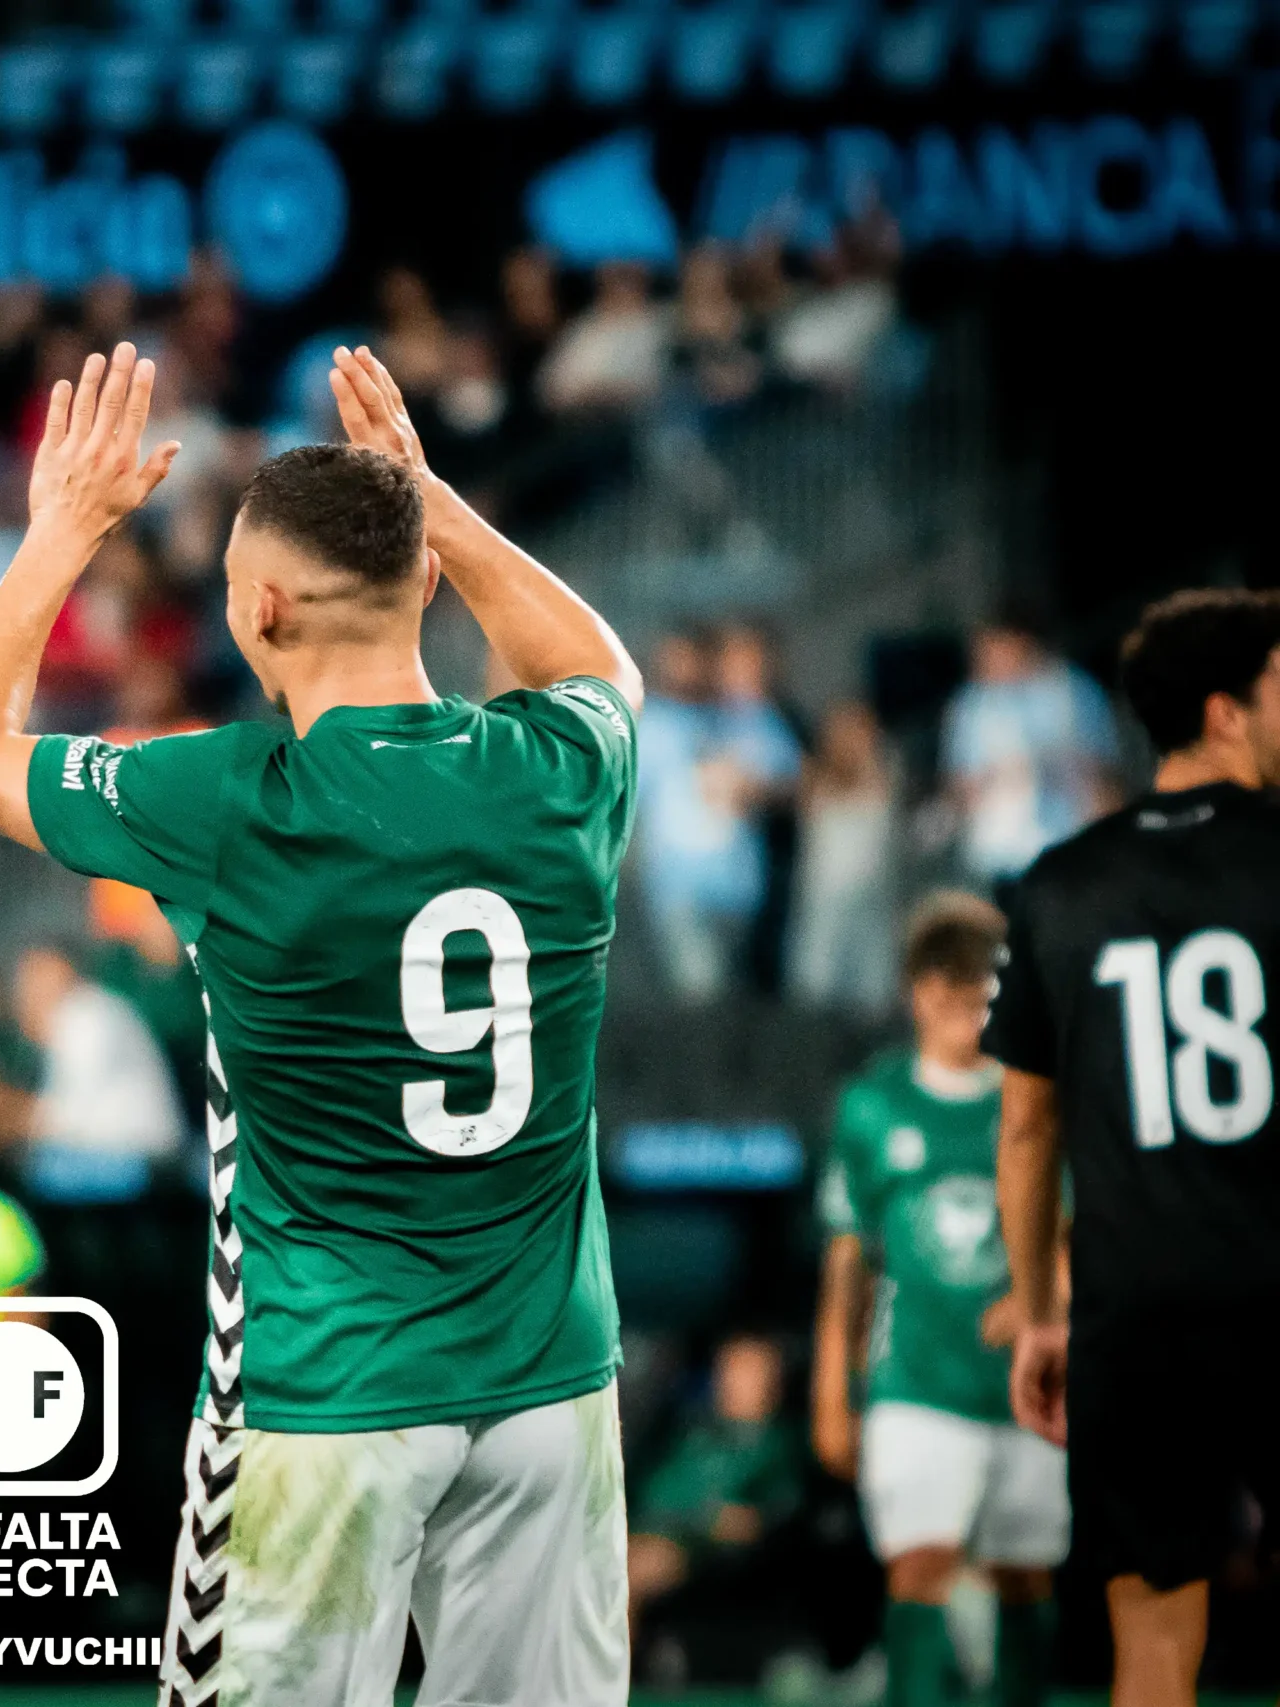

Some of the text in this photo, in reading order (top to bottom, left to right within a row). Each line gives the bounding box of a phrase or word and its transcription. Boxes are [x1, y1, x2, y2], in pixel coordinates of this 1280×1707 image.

[692, 112, 1236, 258] ANCA
[61, 736, 94, 791] ecalvi
[400, 887, 533, 1157] 9
[1092, 927, 1274, 1149] 18
